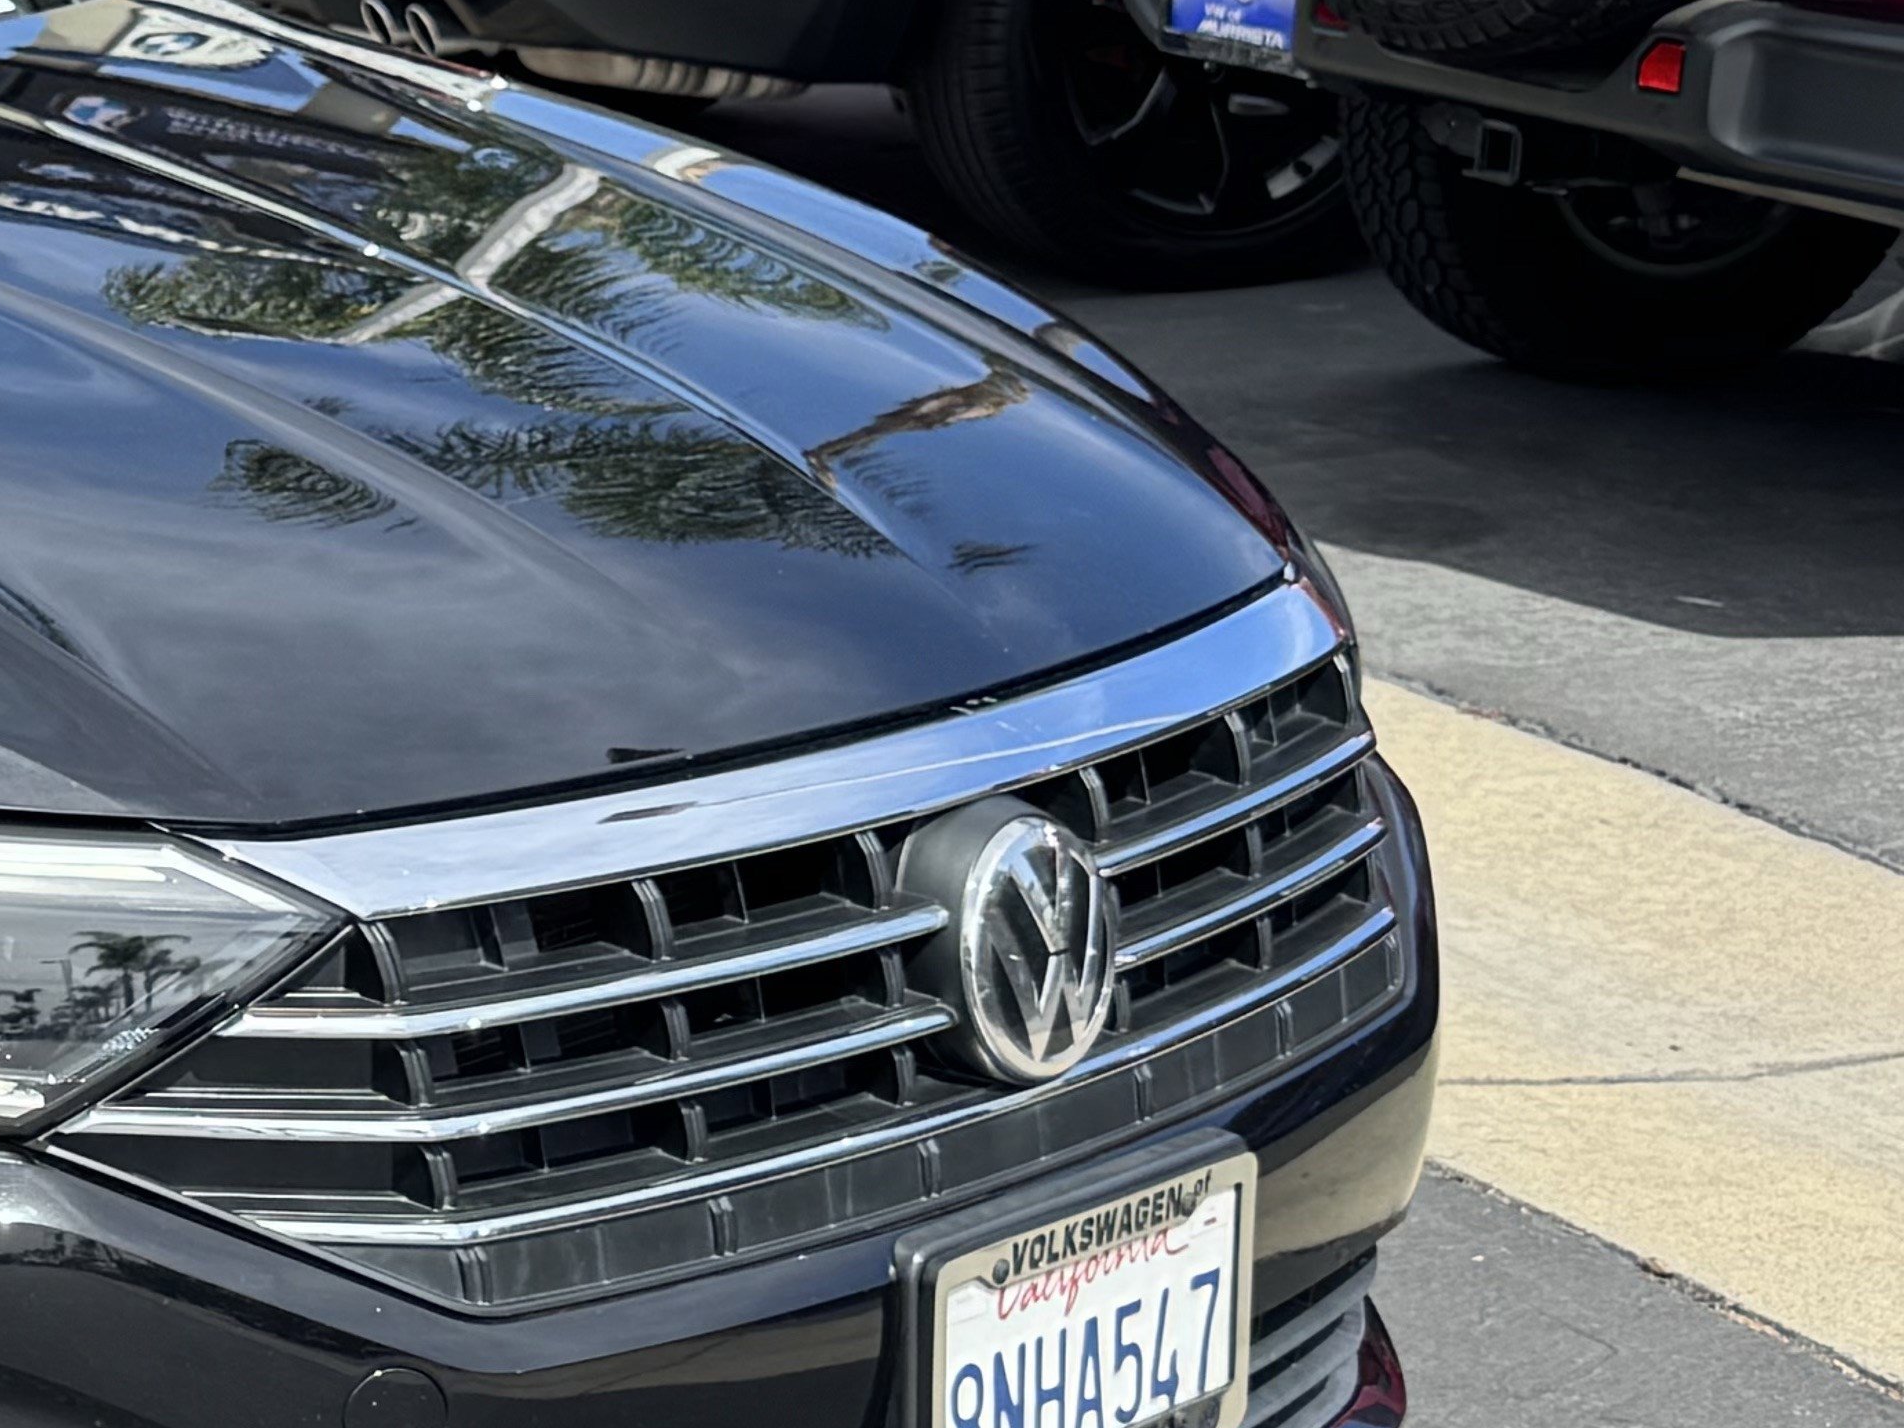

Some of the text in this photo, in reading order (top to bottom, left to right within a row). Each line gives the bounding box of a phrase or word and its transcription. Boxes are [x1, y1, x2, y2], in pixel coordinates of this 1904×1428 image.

[1012, 1169, 1212, 1276] VOLKSWAGEN of
[997, 1226, 1189, 1320] California
